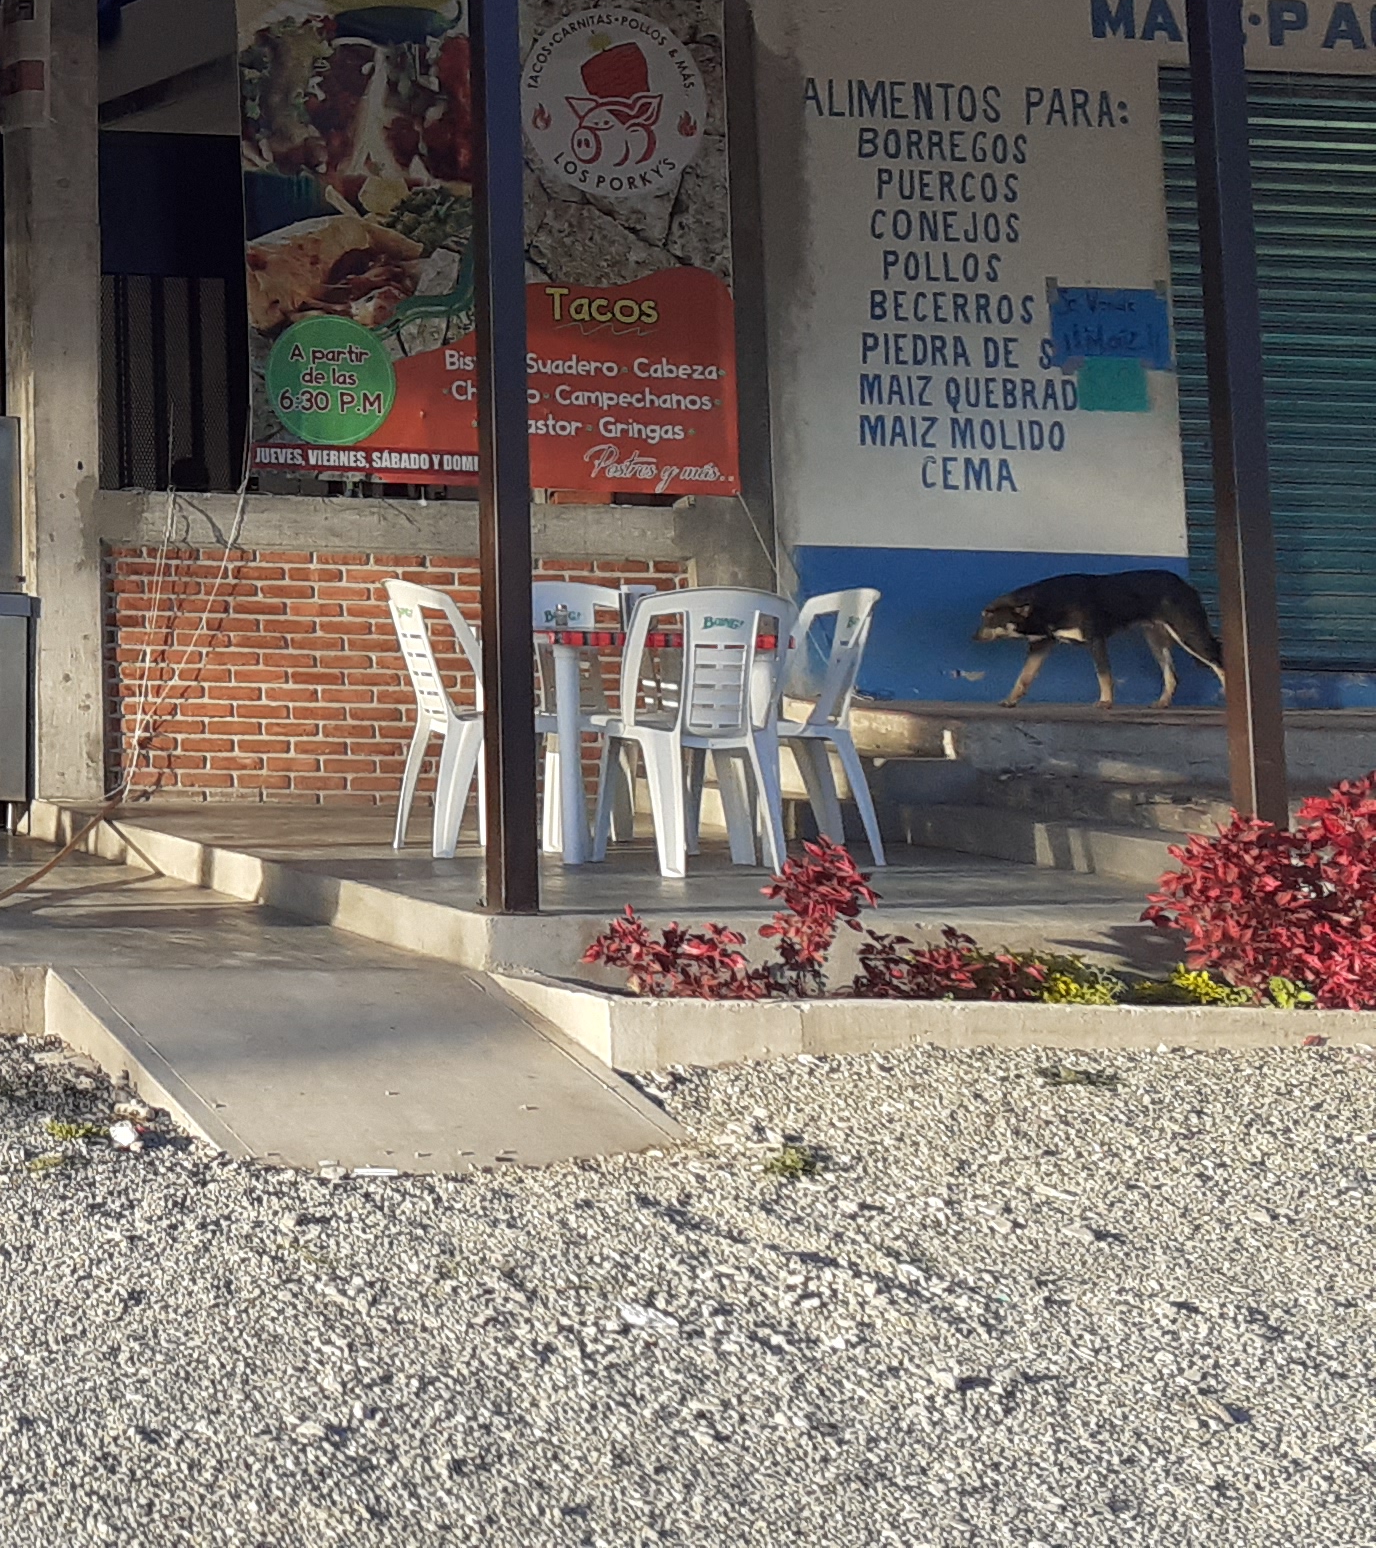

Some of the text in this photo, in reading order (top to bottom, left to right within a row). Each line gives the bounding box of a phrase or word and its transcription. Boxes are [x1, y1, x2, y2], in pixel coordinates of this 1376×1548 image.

[528, 46, 553, 89] TACOS
[552, 14, 613, 44] CARNITAS
[620, 16, 667, 46] POLLOS
[804, 77, 1129, 128] ALIMENTOS PARA:
[857, 127, 1027, 164] BORREGOS
[553, 152, 676, 191] LOS PORKY'S
[876, 168, 1019, 203] PUERCOS
[870, 209, 1020, 243] CONEJOS
[882, 249, 1001, 282] POLLOS
[545, 287, 659, 325] Tacos
[869, 289, 1035, 324] BECERROS
[289, 344, 369, 365] A partir
[526, 353, 618, 376] Suadero
[633, 358, 718, 380] Cabeza
[861, 332, 971, 368] PIEDRA
[983, 337, 1019, 369] DE
[301, 367, 358, 386] de las
[859, 373, 1078, 413] MAIZ QUEBRAD
[279, 388, 383, 414] 6:30 P.M
[555, 385, 712, 410] Campechanos
[527, 414, 684, 444] astor Gringas
[859, 415, 1065, 451] MAIZ MOLIDO
[255, 448, 305, 465] JUEVES,
[308, 449, 369, 468] VIERNES,
[371, 449, 429, 469] SÁBADO
[432, 454, 441, 470] Y
[583, 444, 657, 480] Postres
[654, 467, 680, 494] y
[921, 456, 1018, 492] CEMA
